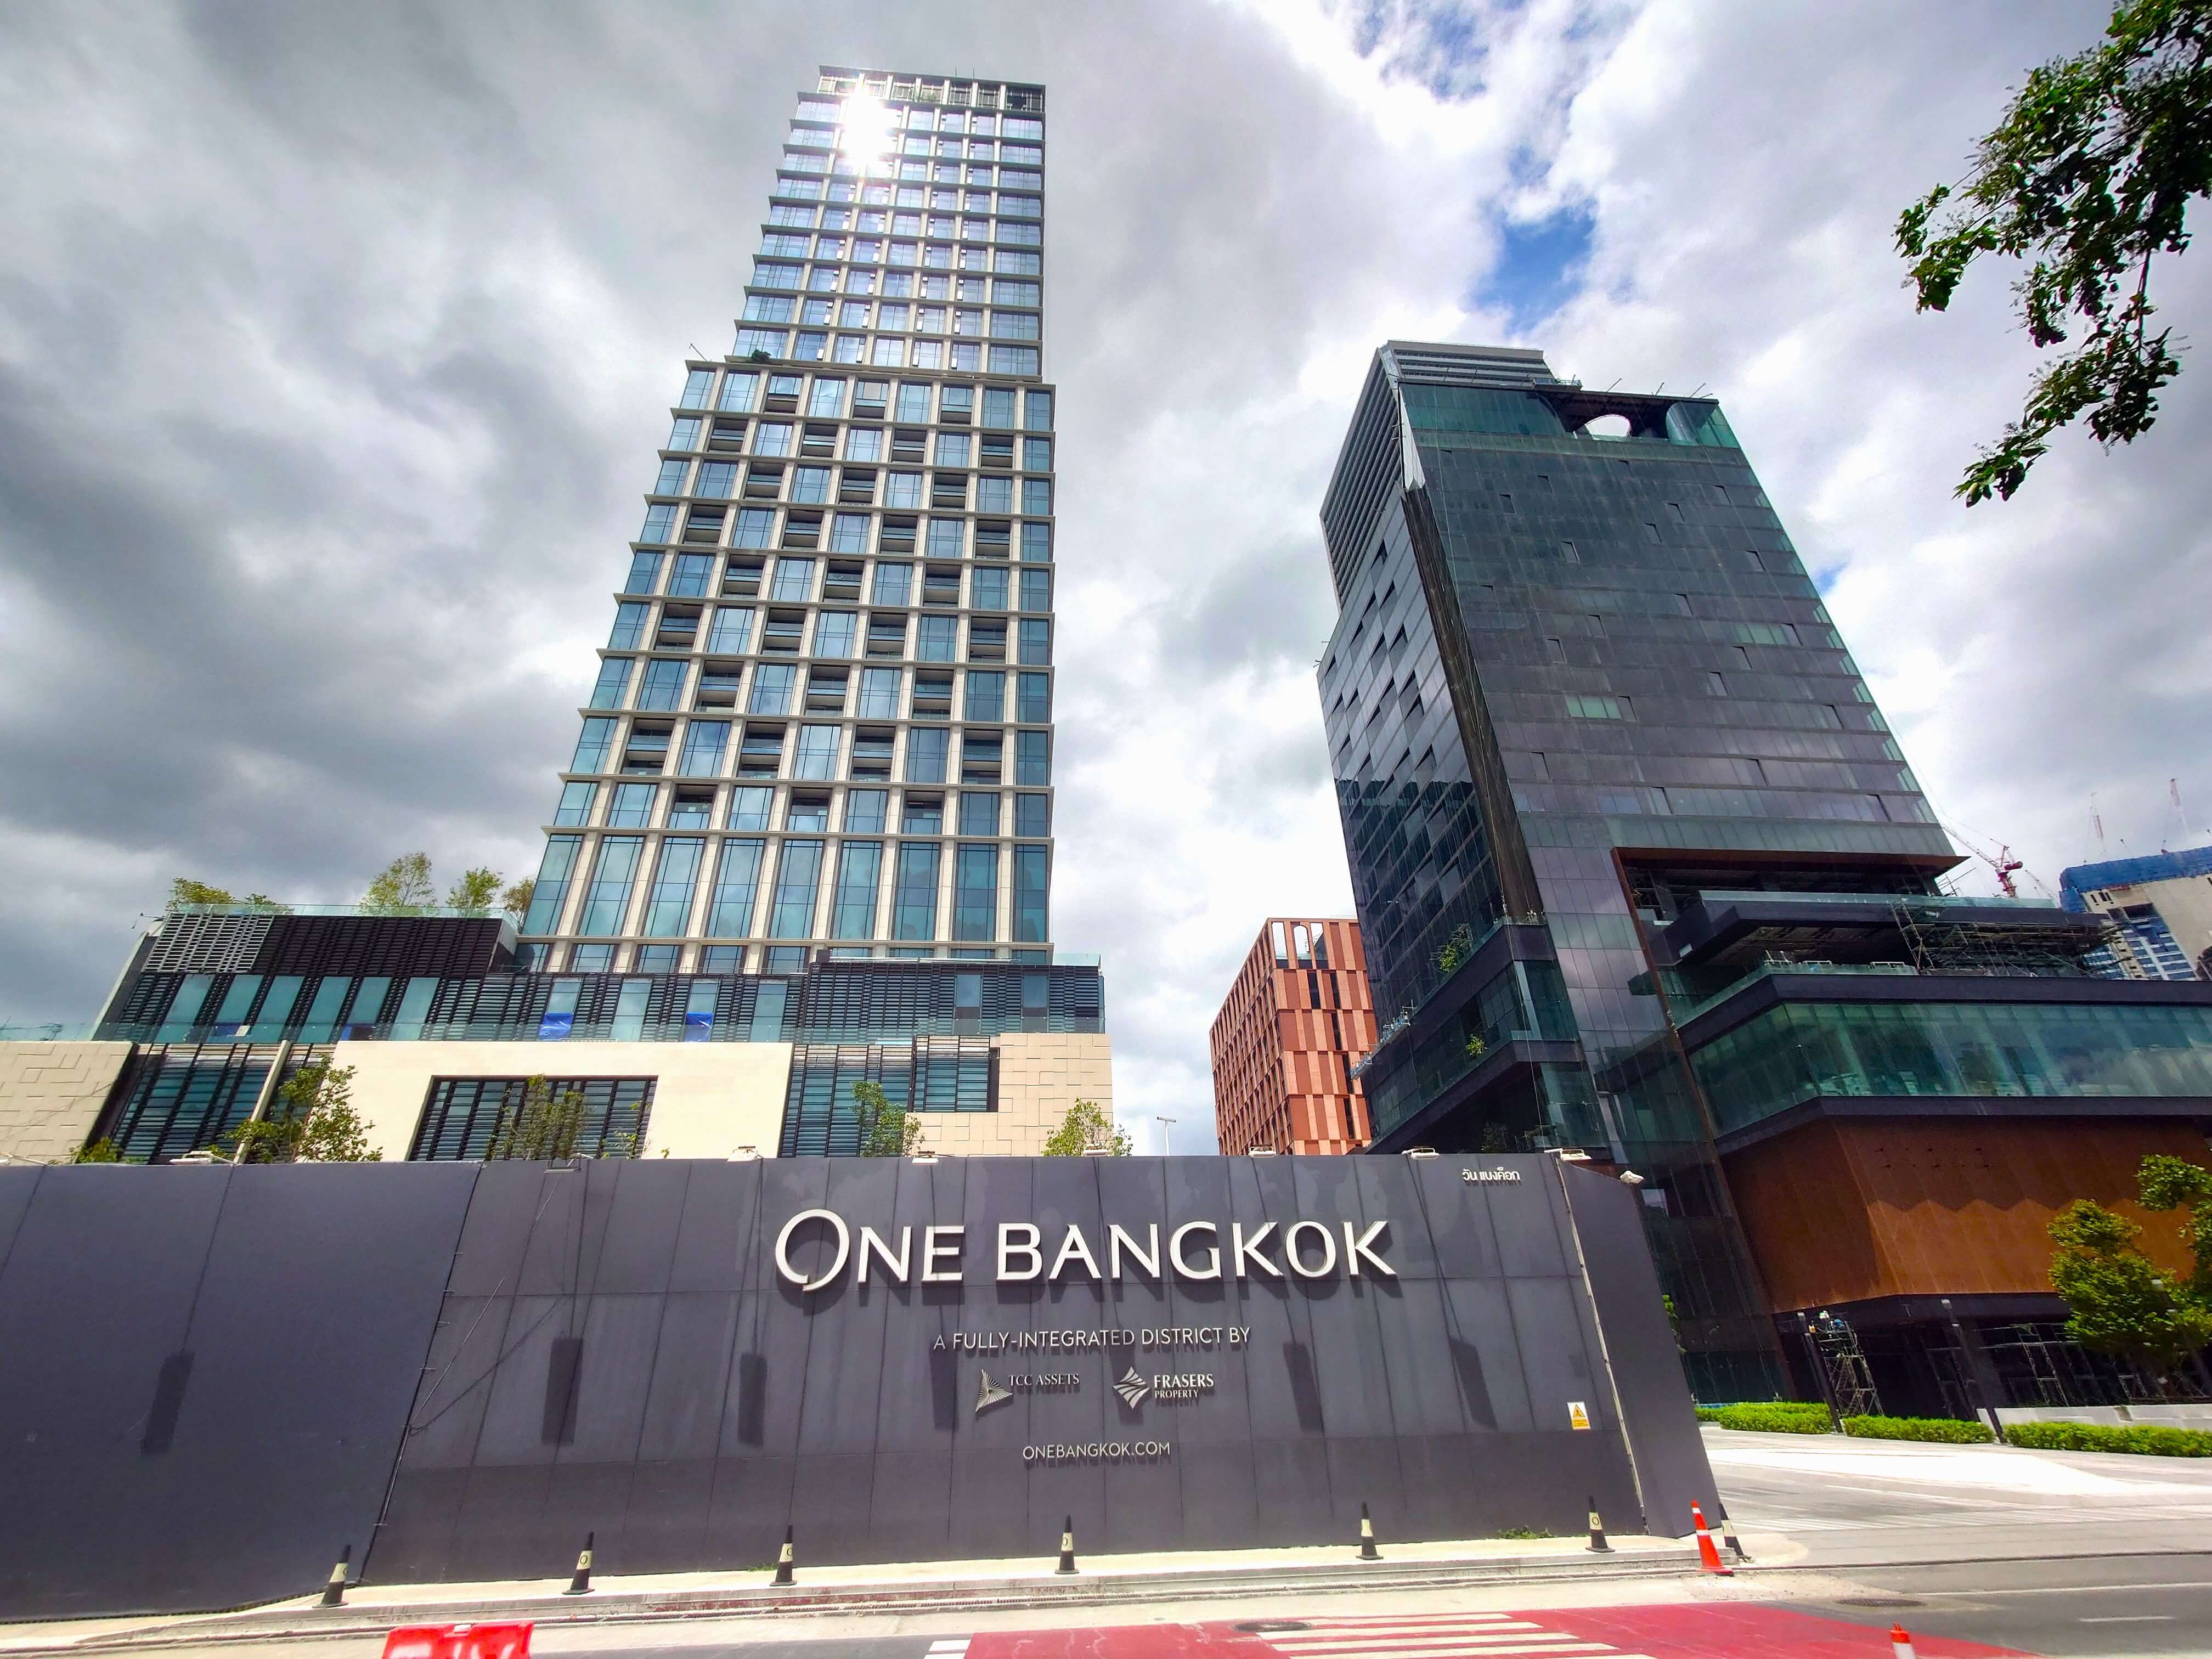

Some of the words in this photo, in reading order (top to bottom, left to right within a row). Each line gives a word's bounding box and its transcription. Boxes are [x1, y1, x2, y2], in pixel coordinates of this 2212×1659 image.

[1462, 1169, 1478, 1181] วัน
[1479, 1167, 1521, 1181] แบงค็อก
[775, 1209, 964, 1291] ONE
[996, 1220, 1397, 1280] BANGKOK
[933, 1334, 946, 1350] A
[953, 1329, 1135, 1350] FULLY-INTEGRATED
[1142, 1327, 1222, 1345] DISTRICT
[1229, 1327, 1250, 1343] BY
[1009, 1374, 1032, 1386] TCC
[1036, 1373, 1080, 1386] ASSETS
[1154, 1374, 1214, 1388] FRASERS
[1155, 1389, 1199, 1399] PROPERTY
[1023, 1441, 1170, 1460] ONEBANGKOK.COM
